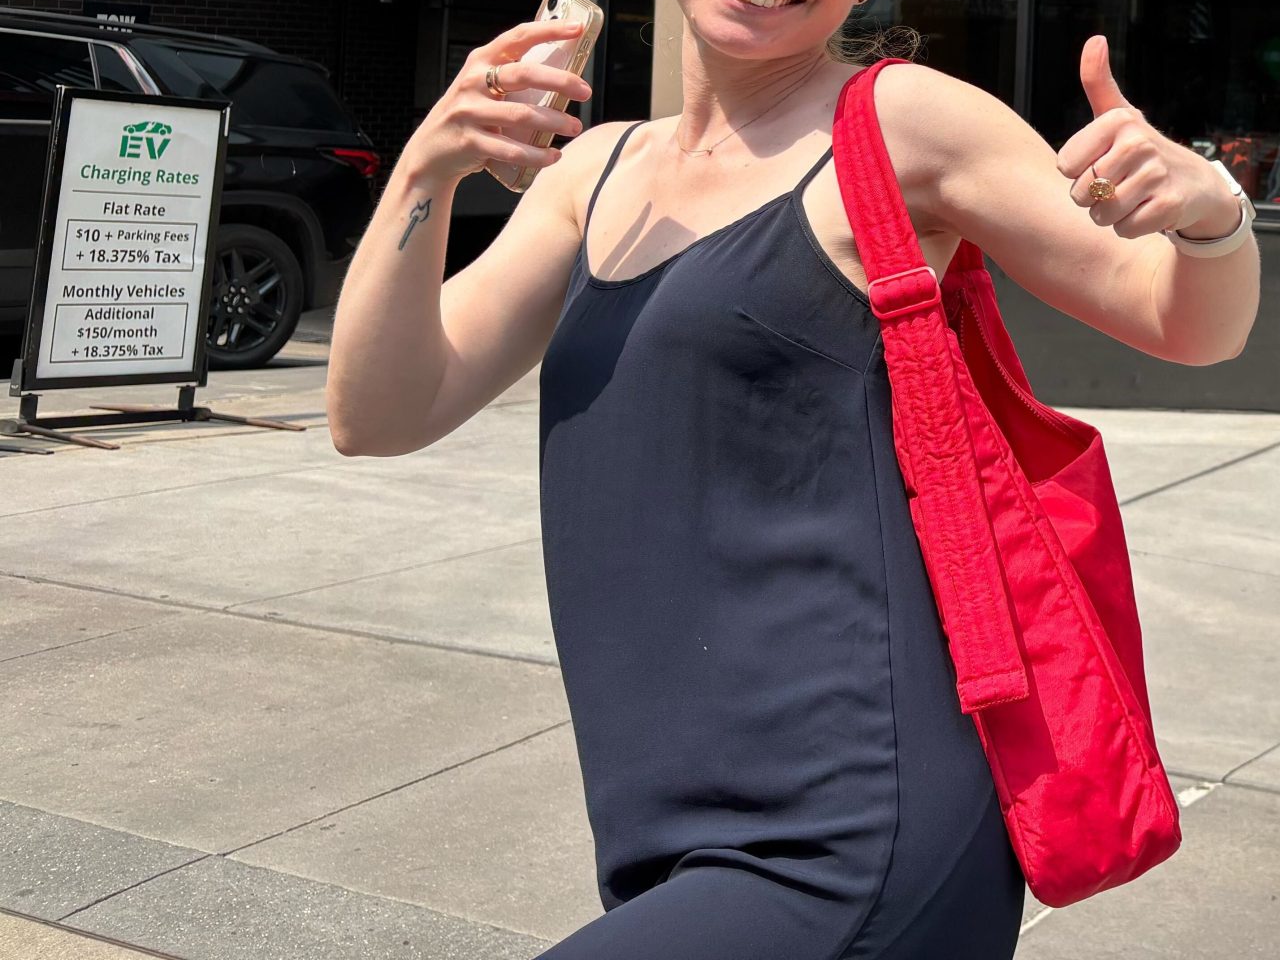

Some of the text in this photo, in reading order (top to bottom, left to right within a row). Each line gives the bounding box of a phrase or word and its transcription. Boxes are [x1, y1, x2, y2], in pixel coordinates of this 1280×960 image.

[119, 135, 171, 160] EV
[80, 164, 199, 186] Charging Rates
[103, 201, 166, 217] Flat Rate
[76, 228, 189, 244] $10 + Parking Fees
[76, 249, 181, 263] + 18.375% Tax
[62, 284, 186, 301] Monthly Vehicles
[84, 307, 155, 321] Additional
[77, 325, 158, 339] $150/month
[71, 344, 164, 358] + 18.375% Tax
